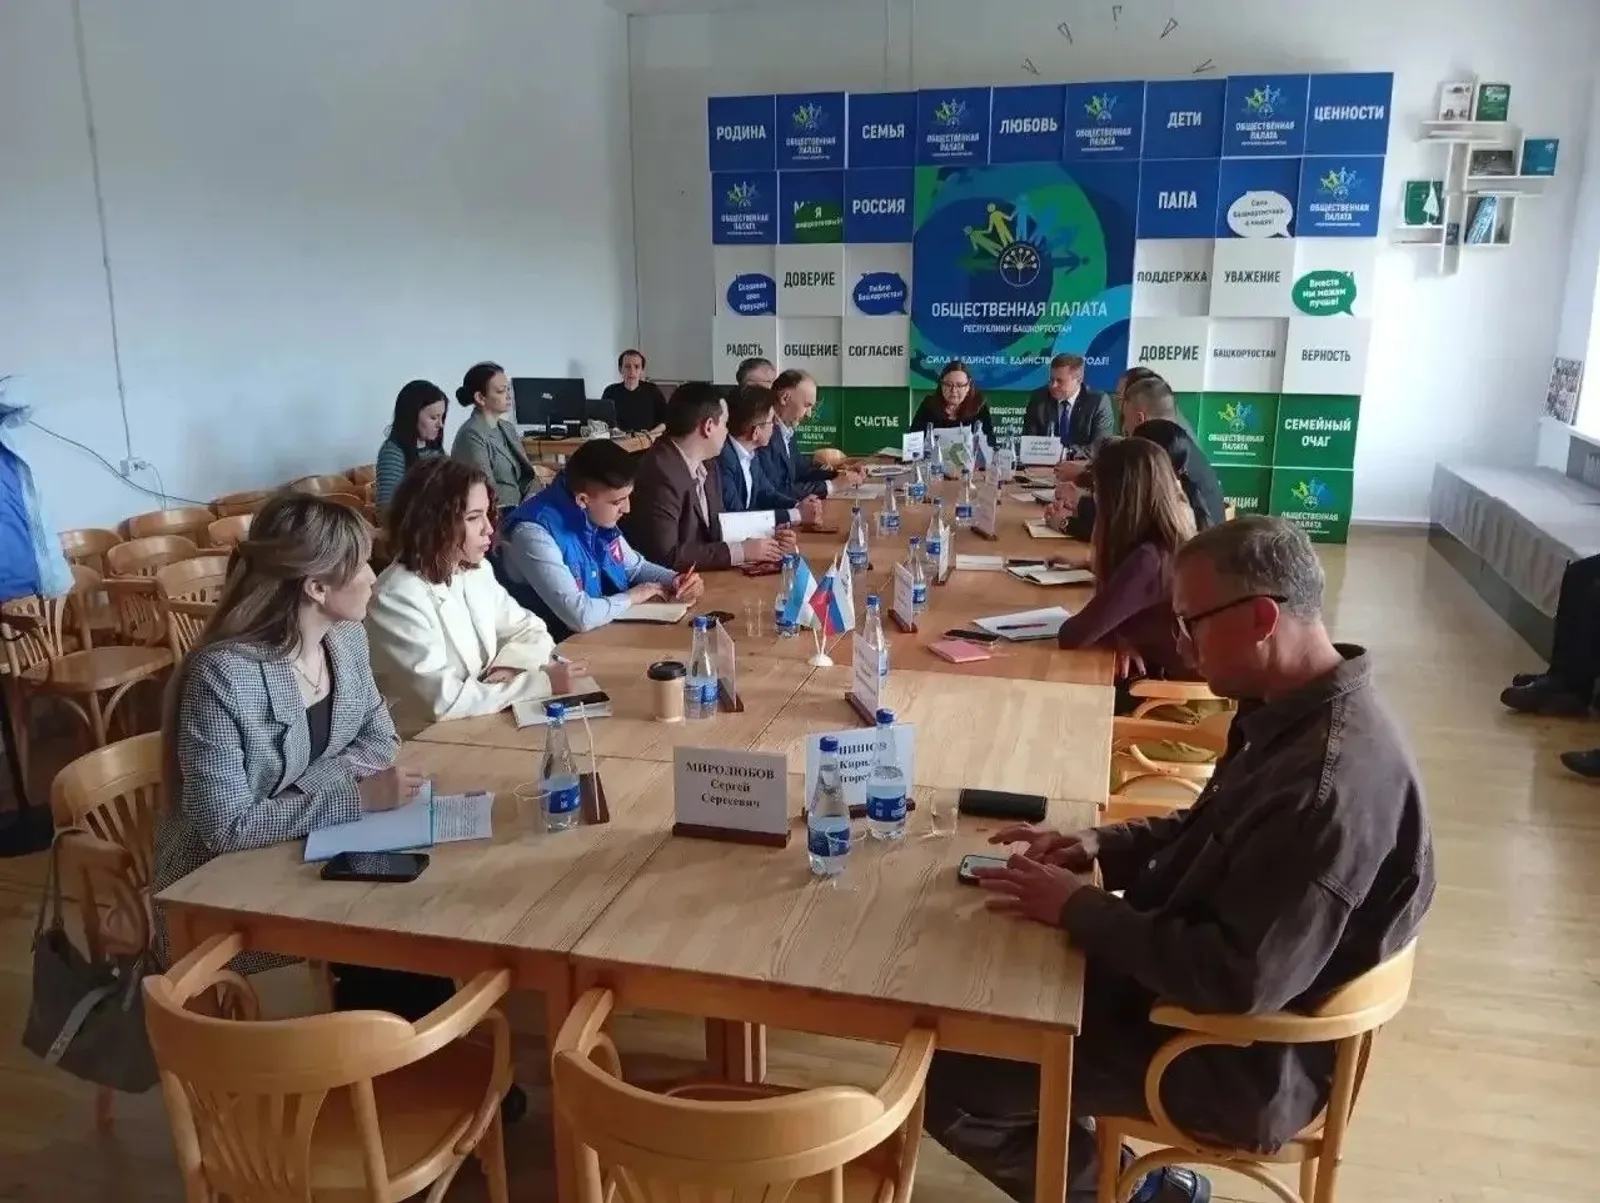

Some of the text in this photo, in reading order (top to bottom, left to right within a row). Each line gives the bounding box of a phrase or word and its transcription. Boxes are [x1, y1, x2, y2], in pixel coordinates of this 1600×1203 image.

[1314, 105, 1384, 121] ЦЕННОСТИ
[1000, 118, 1058, 134] ЛЮБОВЬ
[1167, 112, 1202, 128] ДЕТИ
[1236, 121, 1295, 131] ОБЩЕСТВЕННАЯ
[716, 125, 767, 141] РОДИНА
[862, 124, 905, 139] СЕМЬЯ
[1075, 127, 1132, 137] ОБЩЕСТВЕННАЯ
[1250, 131, 1278, 139] ПАЛАТА
[1089, 137, 1116, 146] ПАЛАТА
[1158, 191, 1197, 209] ПАПА
[815, 207, 822, 218] Я
[852, 199, 905, 214] РОССИЯ
[1310, 203, 1369, 211] ОБЩЕСТВЕННАЯ
[1325, 212, 1352, 220] ПАЛАТА
[784, 272, 835, 288] ДОВЕРИЕ
[1137, 271, 1208, 283] ПОДДЕРЖКА
[1224, 270, 1281, 283] УВАЖЕНИЕ
[932, 302, 1107, 318] ОБЩЕСТВЕННАЯ ПАЛАТА
[963, 325, 1072, 333] РЕСПУБЛИКИ БАШКОРТОСТАН
[727, 343, 763, 357] РАДОСТЬ
[784, 344, 838, 357] ОБЩЕНИЕ
[848, 345, 903, 357] СОГЛАСИЕ
[1139, 346, 1199, 362] ДОВЕРИЕ
[1213, 349, 1276, 358] БАШКОРТОСТАН
[1301, 350, 1352, 362] ВЕРНОСТЬ
[926, 355, 951, 364] СИЛА
[1010, 356, 1052, 365] ЕДИНСТВ
[854, 416, 899, 427] СЧАСТЬЕ
[1285, 417, 1352, 431] СЕМЕЙНЫЙ
[1208, 434, 1264, 442] ОБЩЕСТВЕННАЯ
[1301, 436, 1331, 447] ОЧАГ
[1222, 442, 1248, 450] ПАЛАТА
[686, 762, 774, 779] МИРОЛЮБОВ
[710, 779, 751, 793] Сергей
[701, 793, 760, 807] Сергеевич
